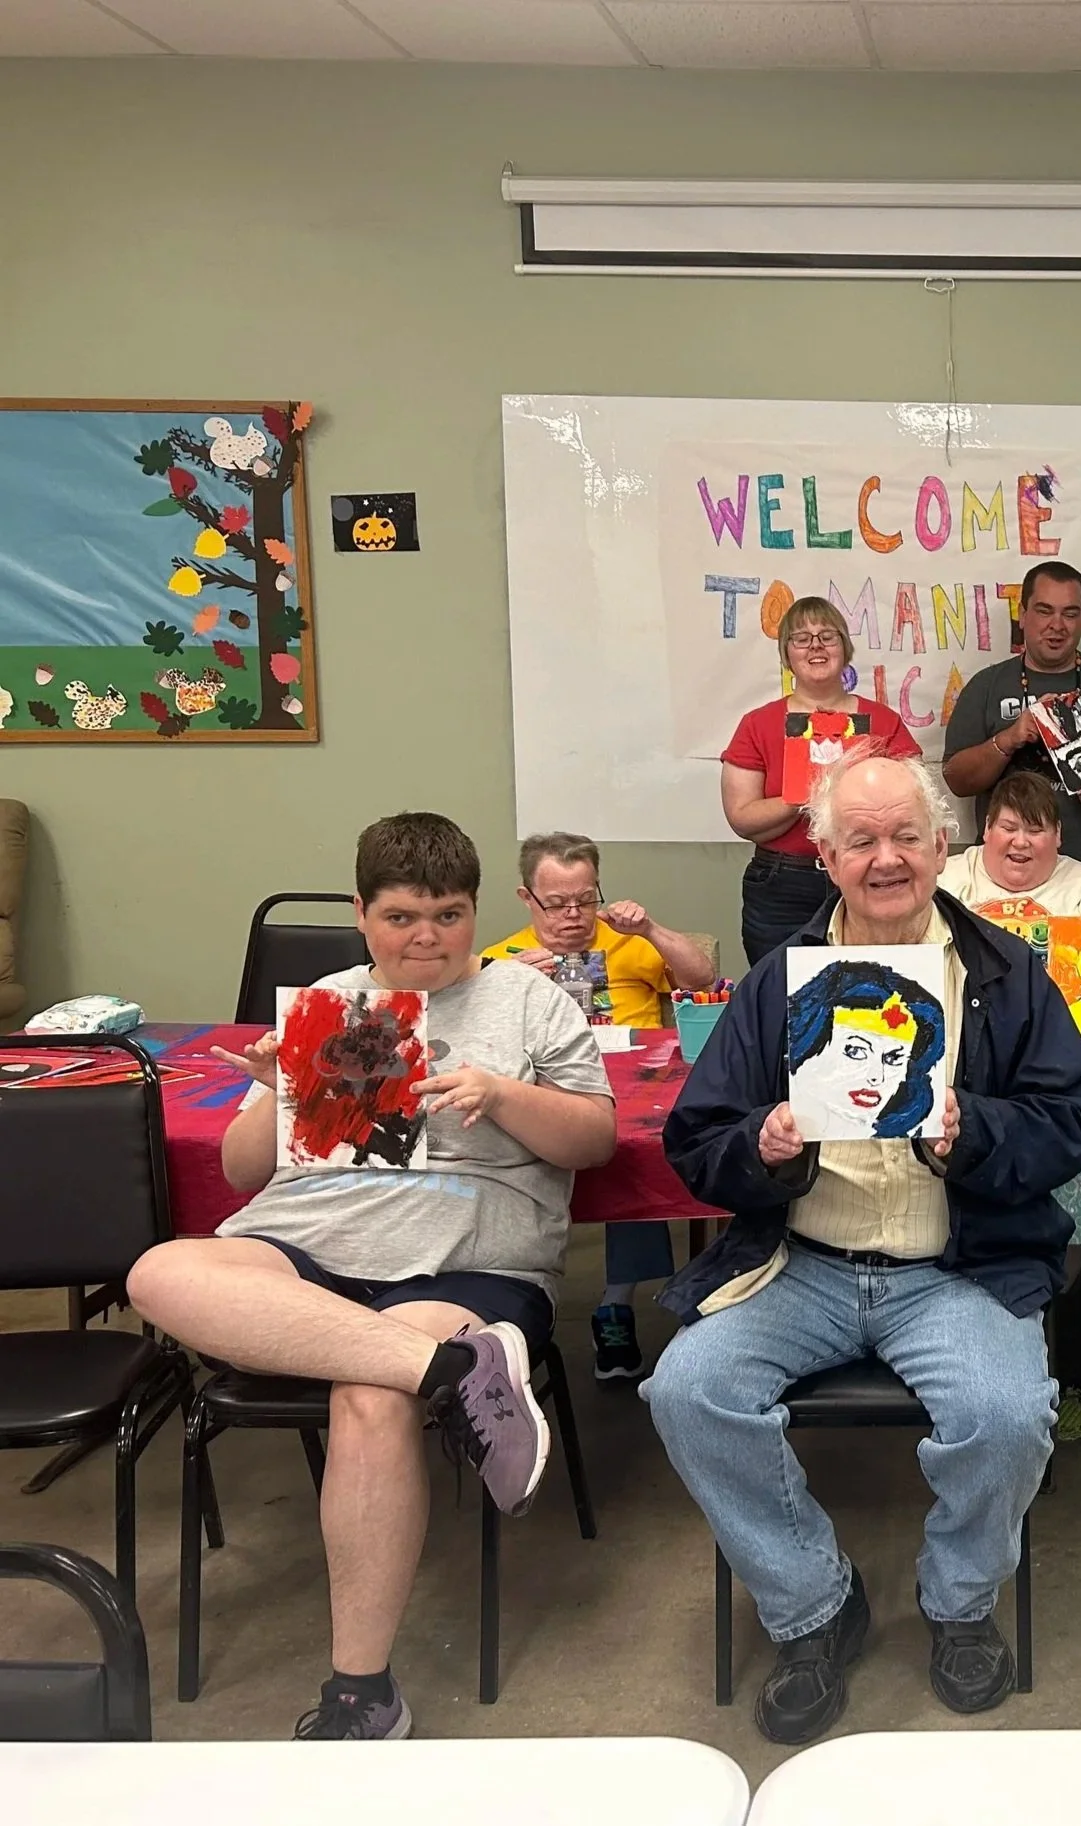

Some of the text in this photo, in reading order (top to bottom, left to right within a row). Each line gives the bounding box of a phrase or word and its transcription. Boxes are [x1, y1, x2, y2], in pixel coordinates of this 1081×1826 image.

[697, 474, 1061, 556] WELCOME
[704, 574, 795, 640] TO
[1002, 900, 1028, 918] BE
